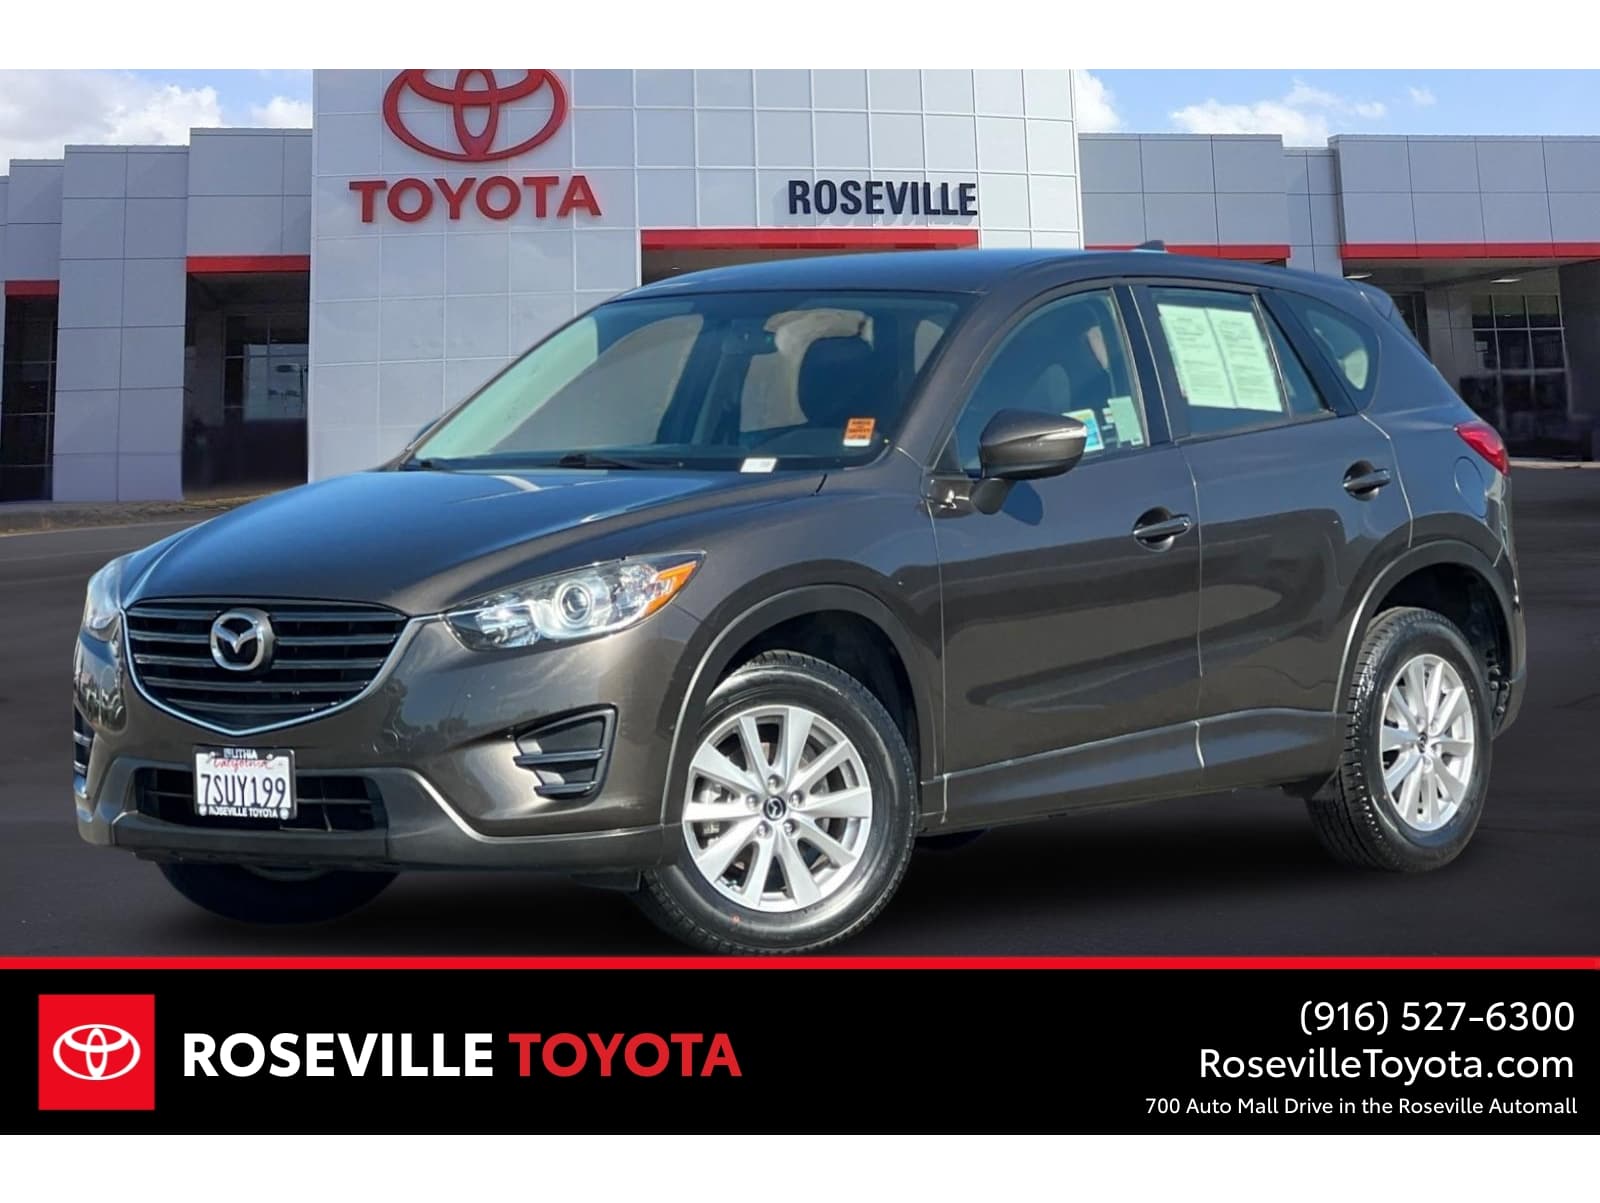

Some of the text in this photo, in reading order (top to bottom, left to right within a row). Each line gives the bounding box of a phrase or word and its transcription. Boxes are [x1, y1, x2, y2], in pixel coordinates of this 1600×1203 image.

[349, 175, 602, 223] TOYOTA
[788, 180, 978, 216] ROSEVILLE
[200, 773, 287, 808] 7SUY199
[208, 806, 279, 819] ROSEVILLE TOYOTA
